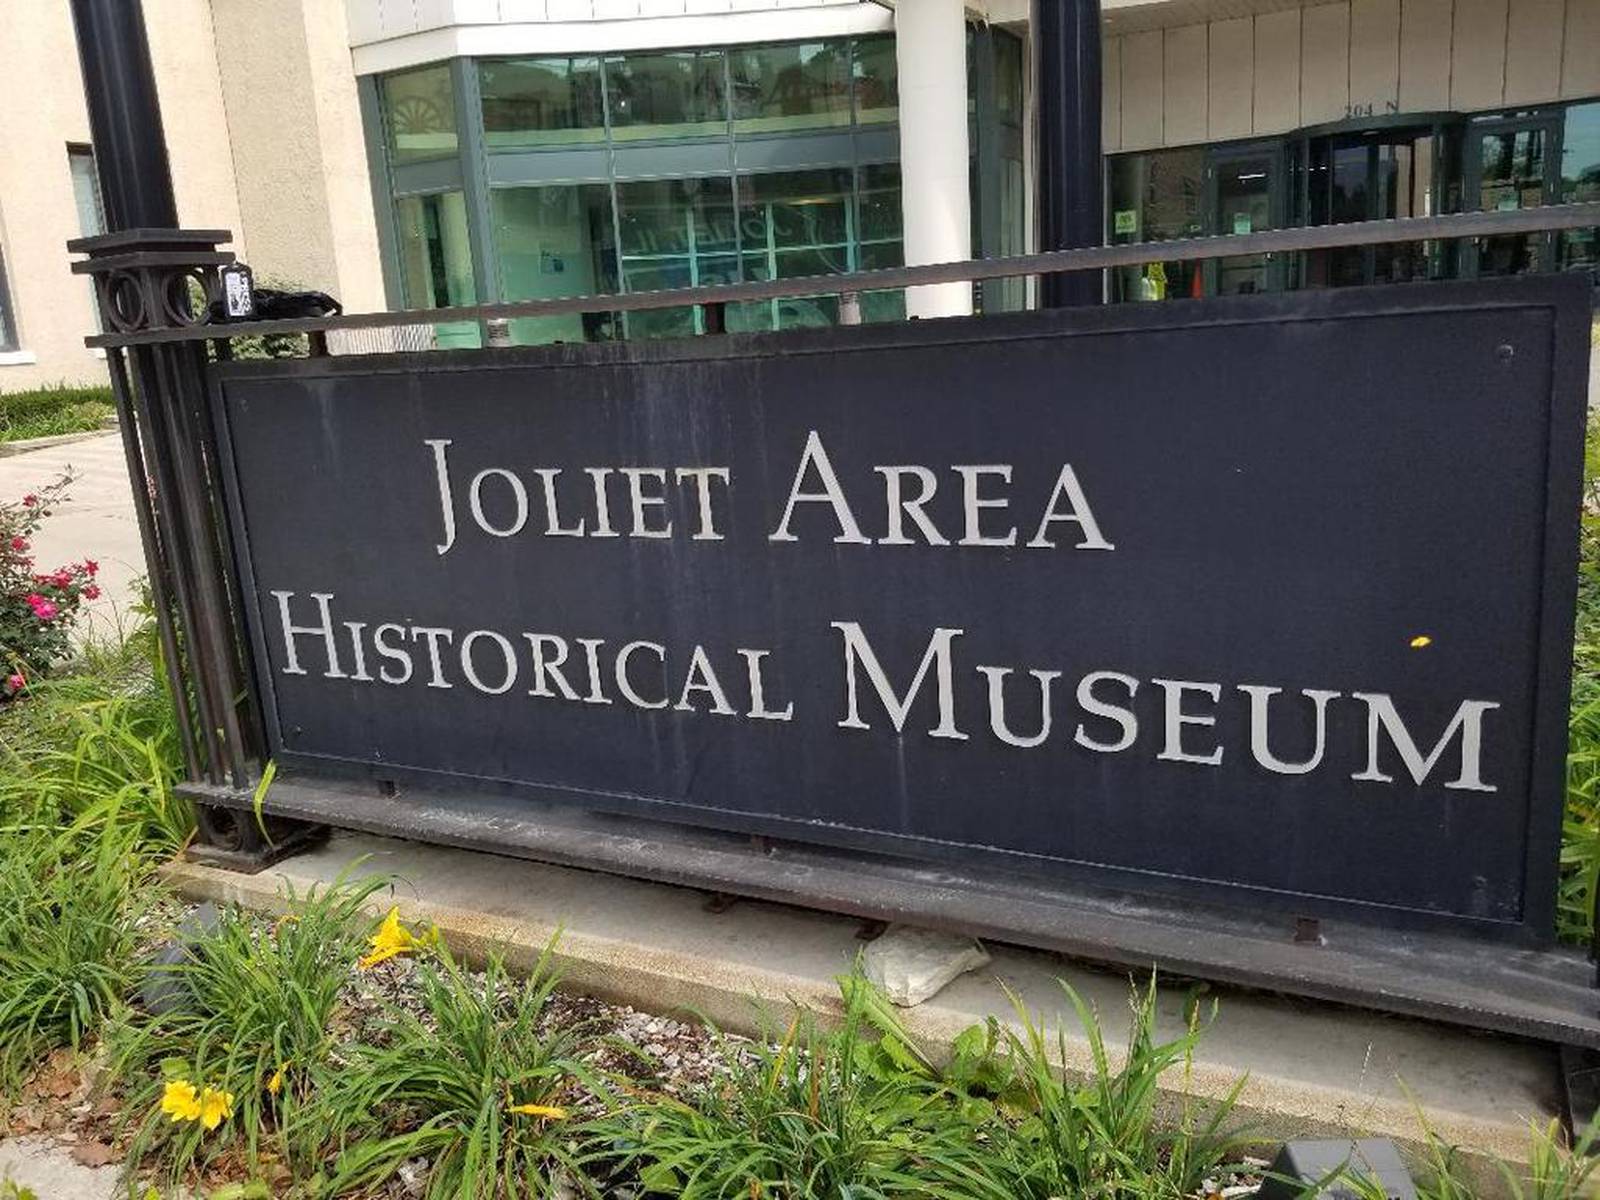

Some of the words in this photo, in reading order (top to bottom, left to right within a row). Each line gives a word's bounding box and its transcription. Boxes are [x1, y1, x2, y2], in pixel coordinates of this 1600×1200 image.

[424, 438, 731, 556] JOLIET
[768, 429, 1116, 552] AREA
[270, 590, 795, 722] HISTORICAL
[830, 620, 1501, 793] MUSEUM
